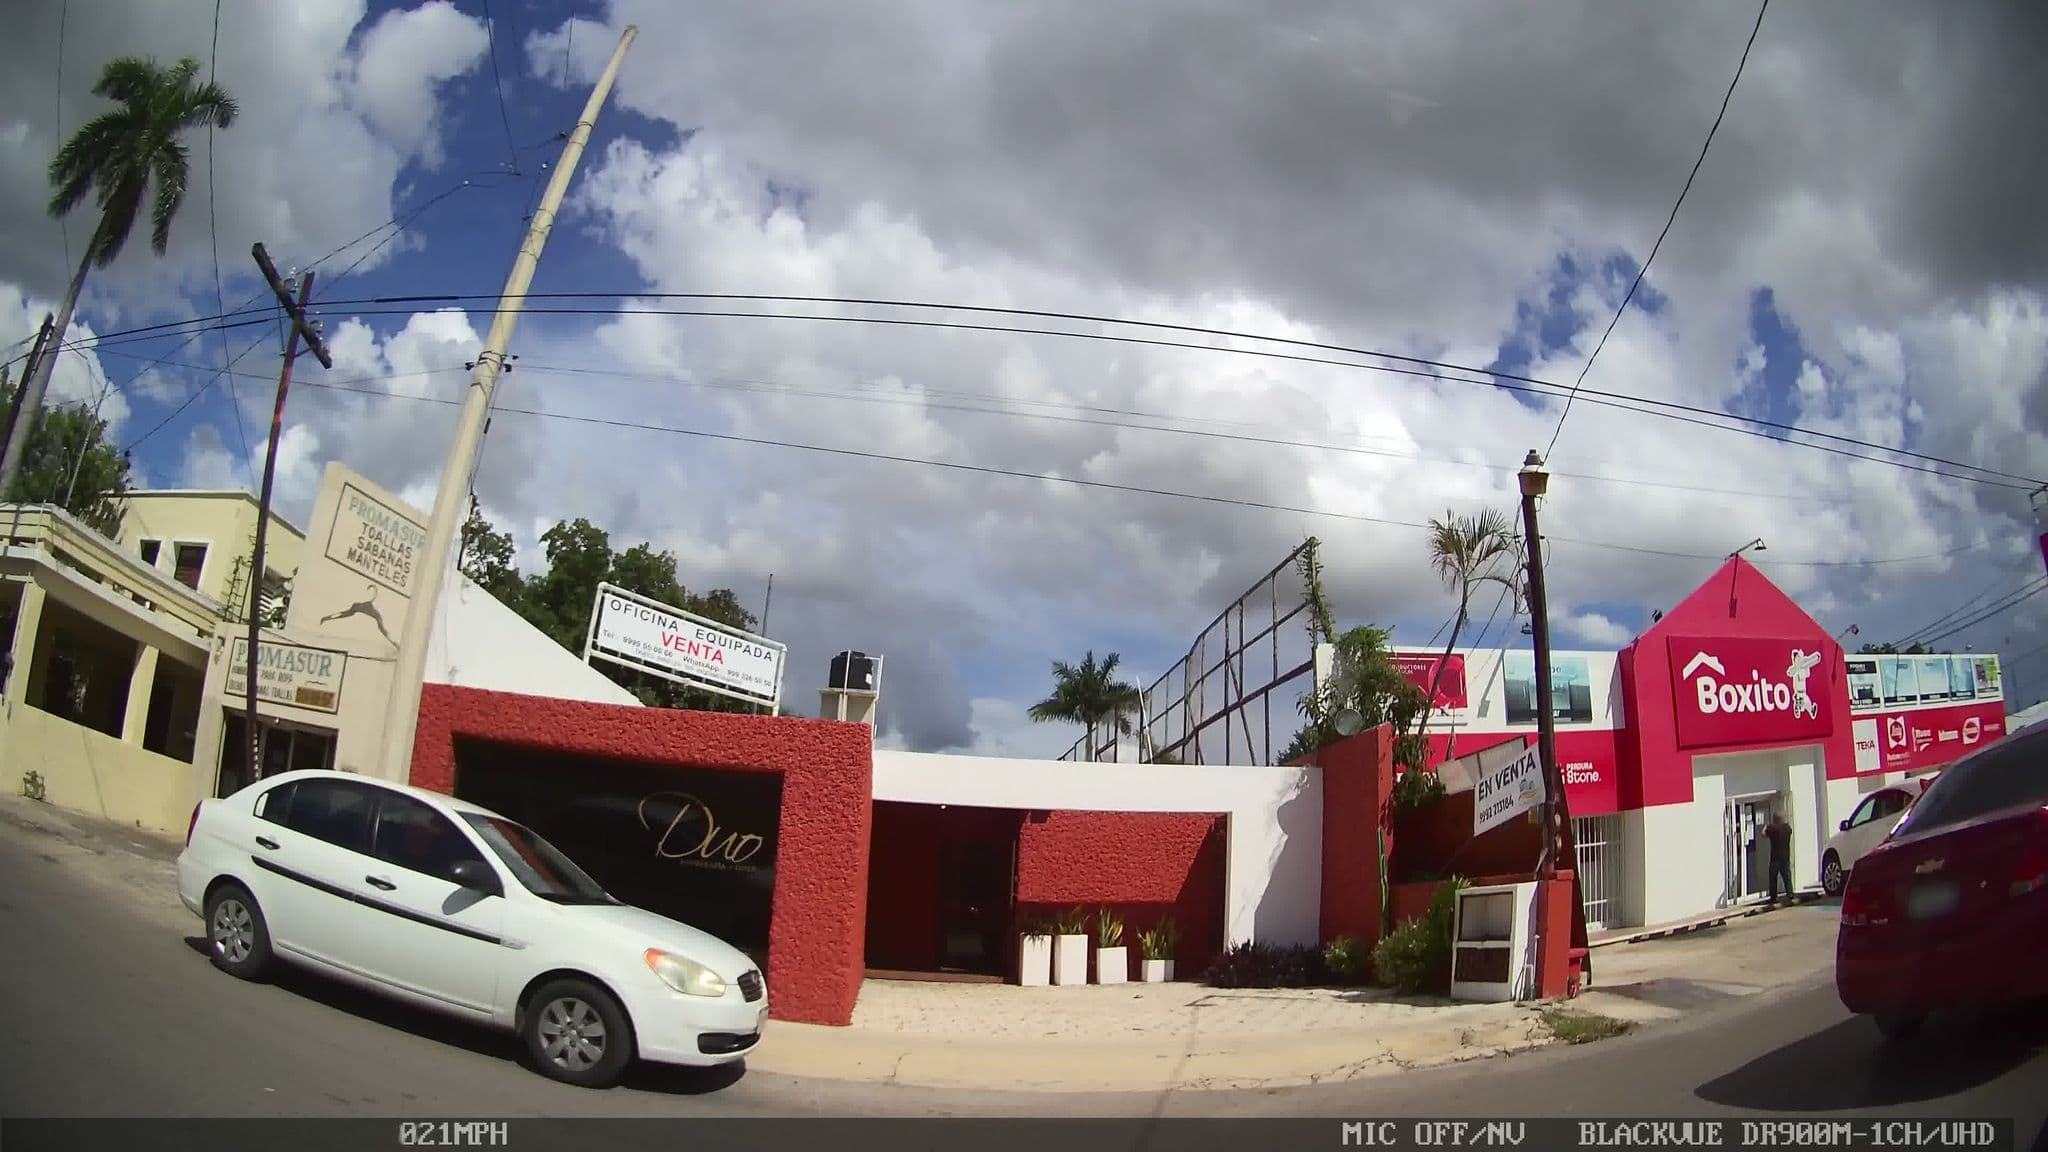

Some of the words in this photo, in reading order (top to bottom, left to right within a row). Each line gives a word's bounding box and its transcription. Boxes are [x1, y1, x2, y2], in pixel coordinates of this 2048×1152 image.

[357, 536, 411, 574] SABANAS
[361, 521, 413, 559] TOALLAS
[346, 547, 407, 588] MANTELES
[610, 599, 679, 632] OFICINA
[696, 628, 773, 661] EQUIPADA
[661, 631, 724, 664] VENTA
[237, 642, 333, 677] POMASUR
[1697, 669, 1791, 714] Boxito
[1856, 740, 1876, 751] TEKA
[1478, 777, 1493, 802] EN
[1495, 752, 1536, 792] VENTA
[639, 792, 764, 864] Duo
